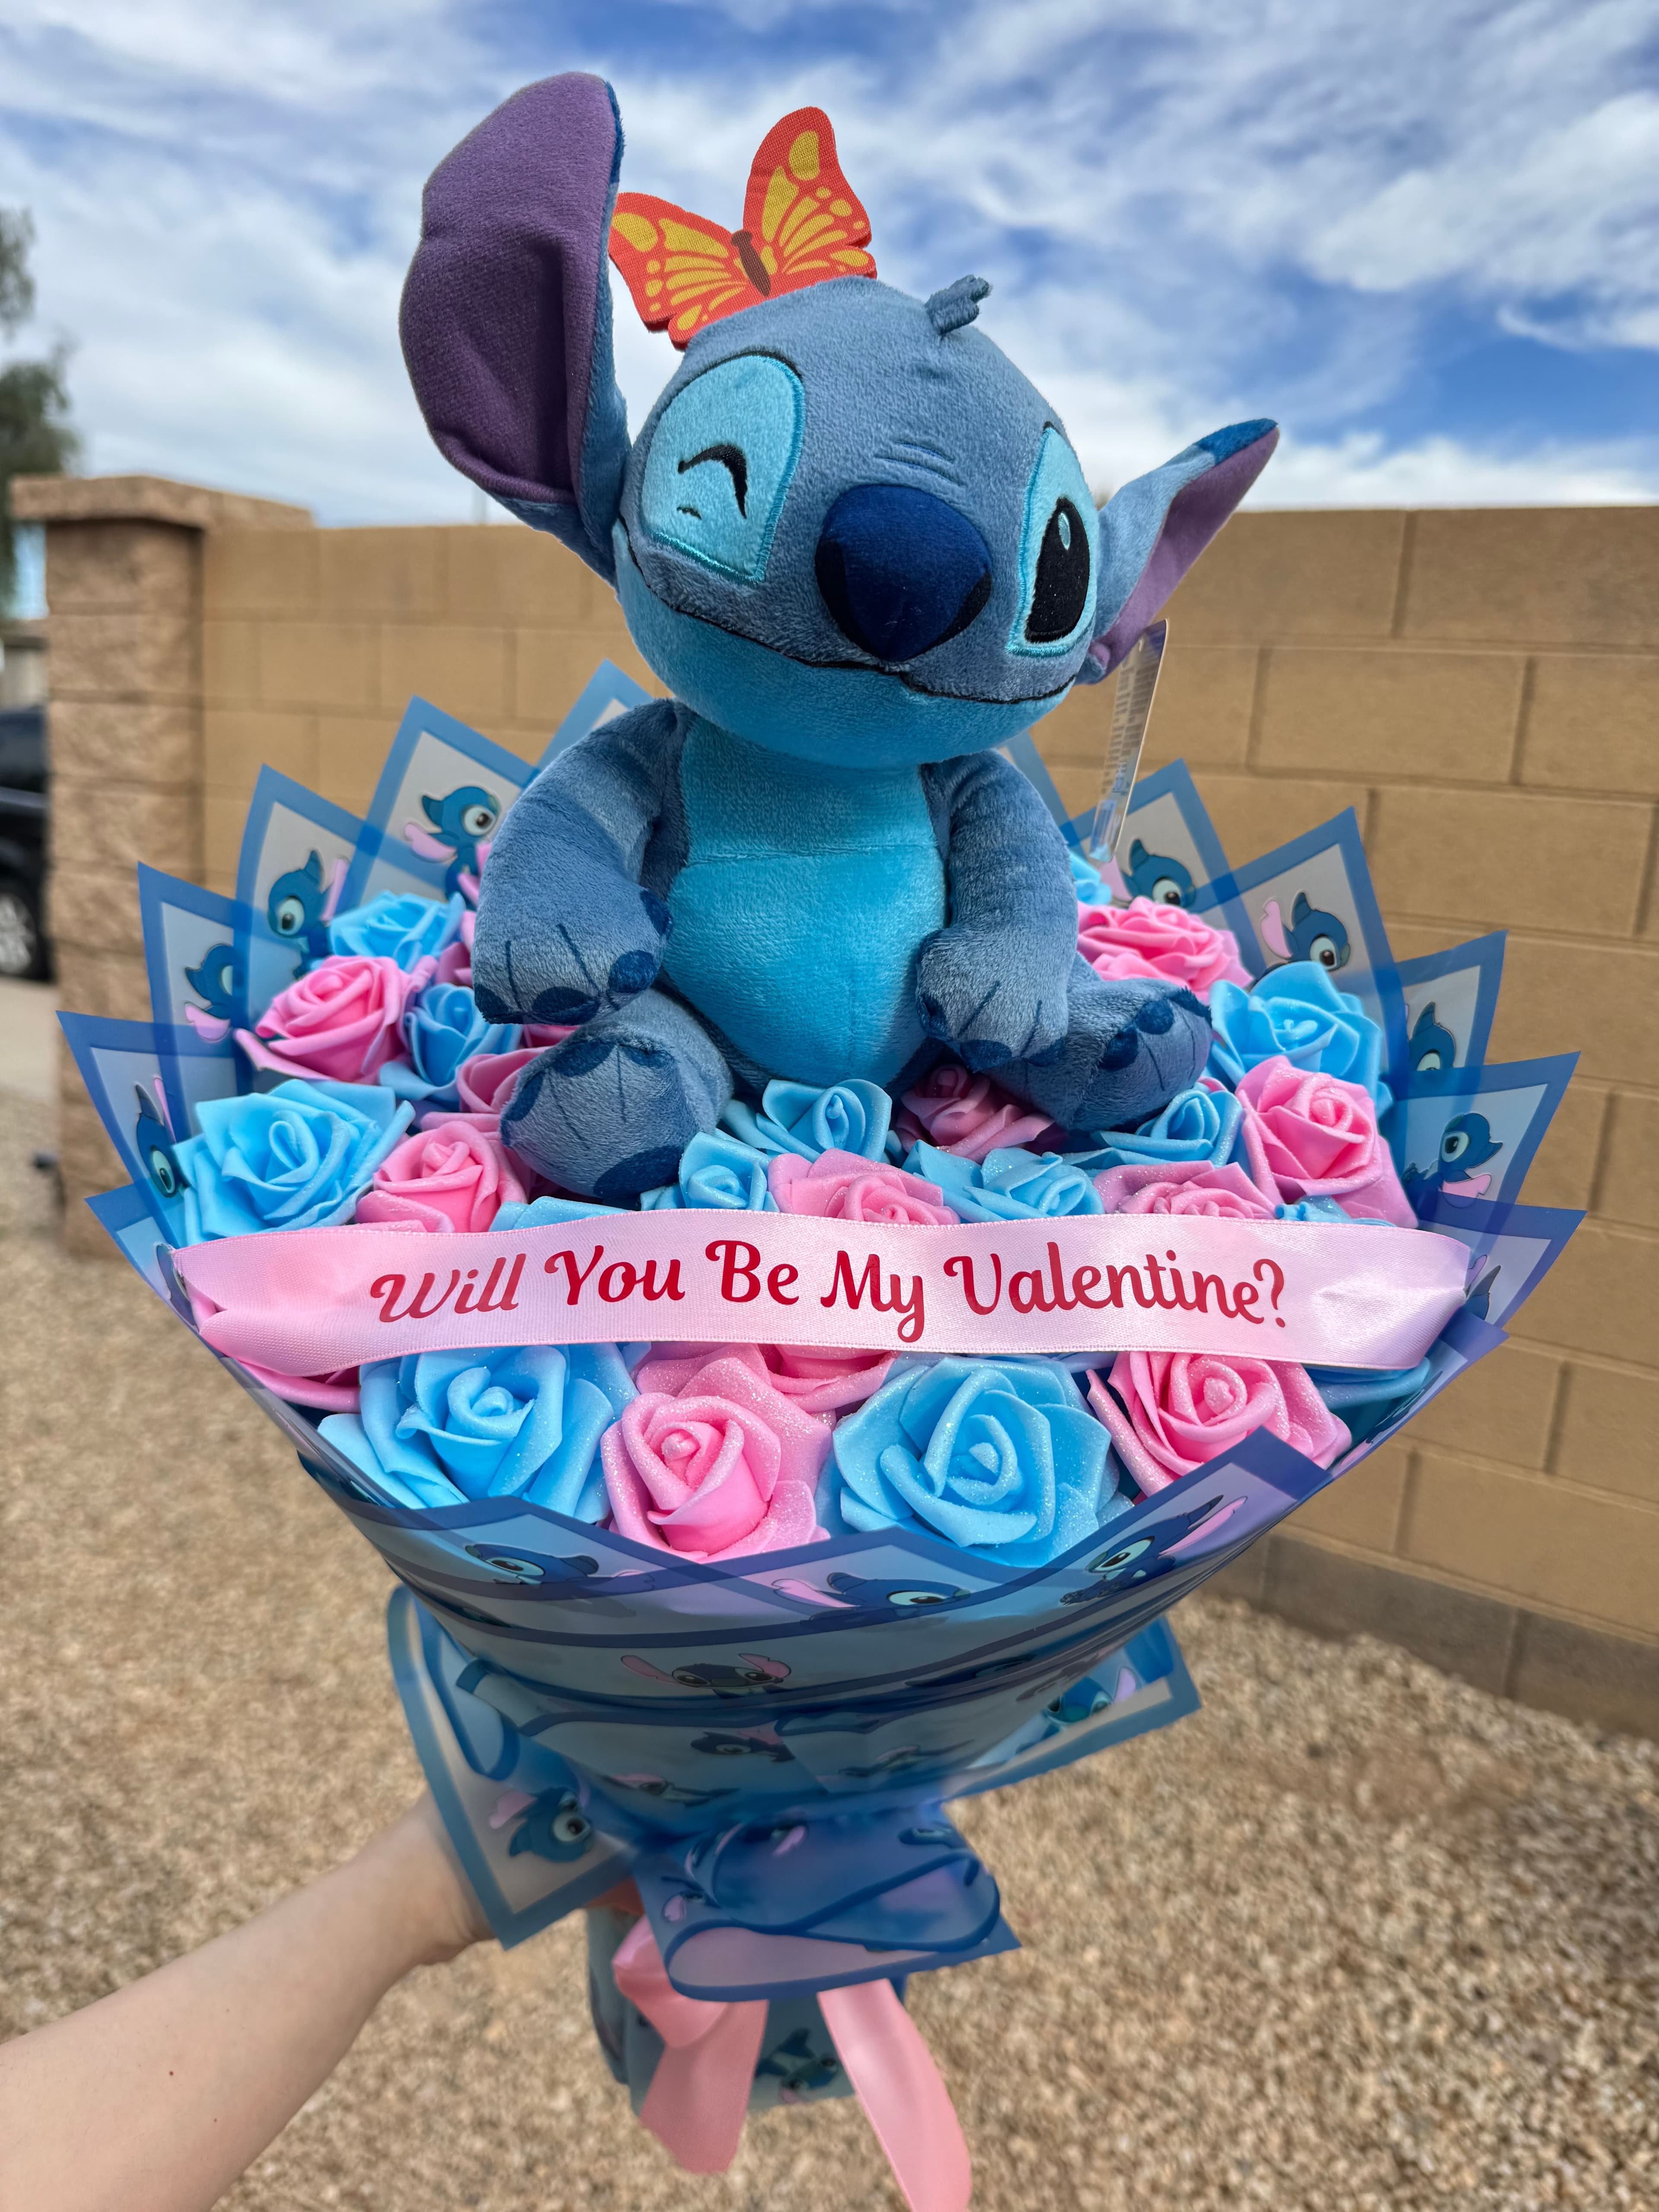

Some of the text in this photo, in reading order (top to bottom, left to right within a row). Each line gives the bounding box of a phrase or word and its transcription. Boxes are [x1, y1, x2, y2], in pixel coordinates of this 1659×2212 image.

[370, 1240, 1285, 1342] Will You Be My Valentine?
